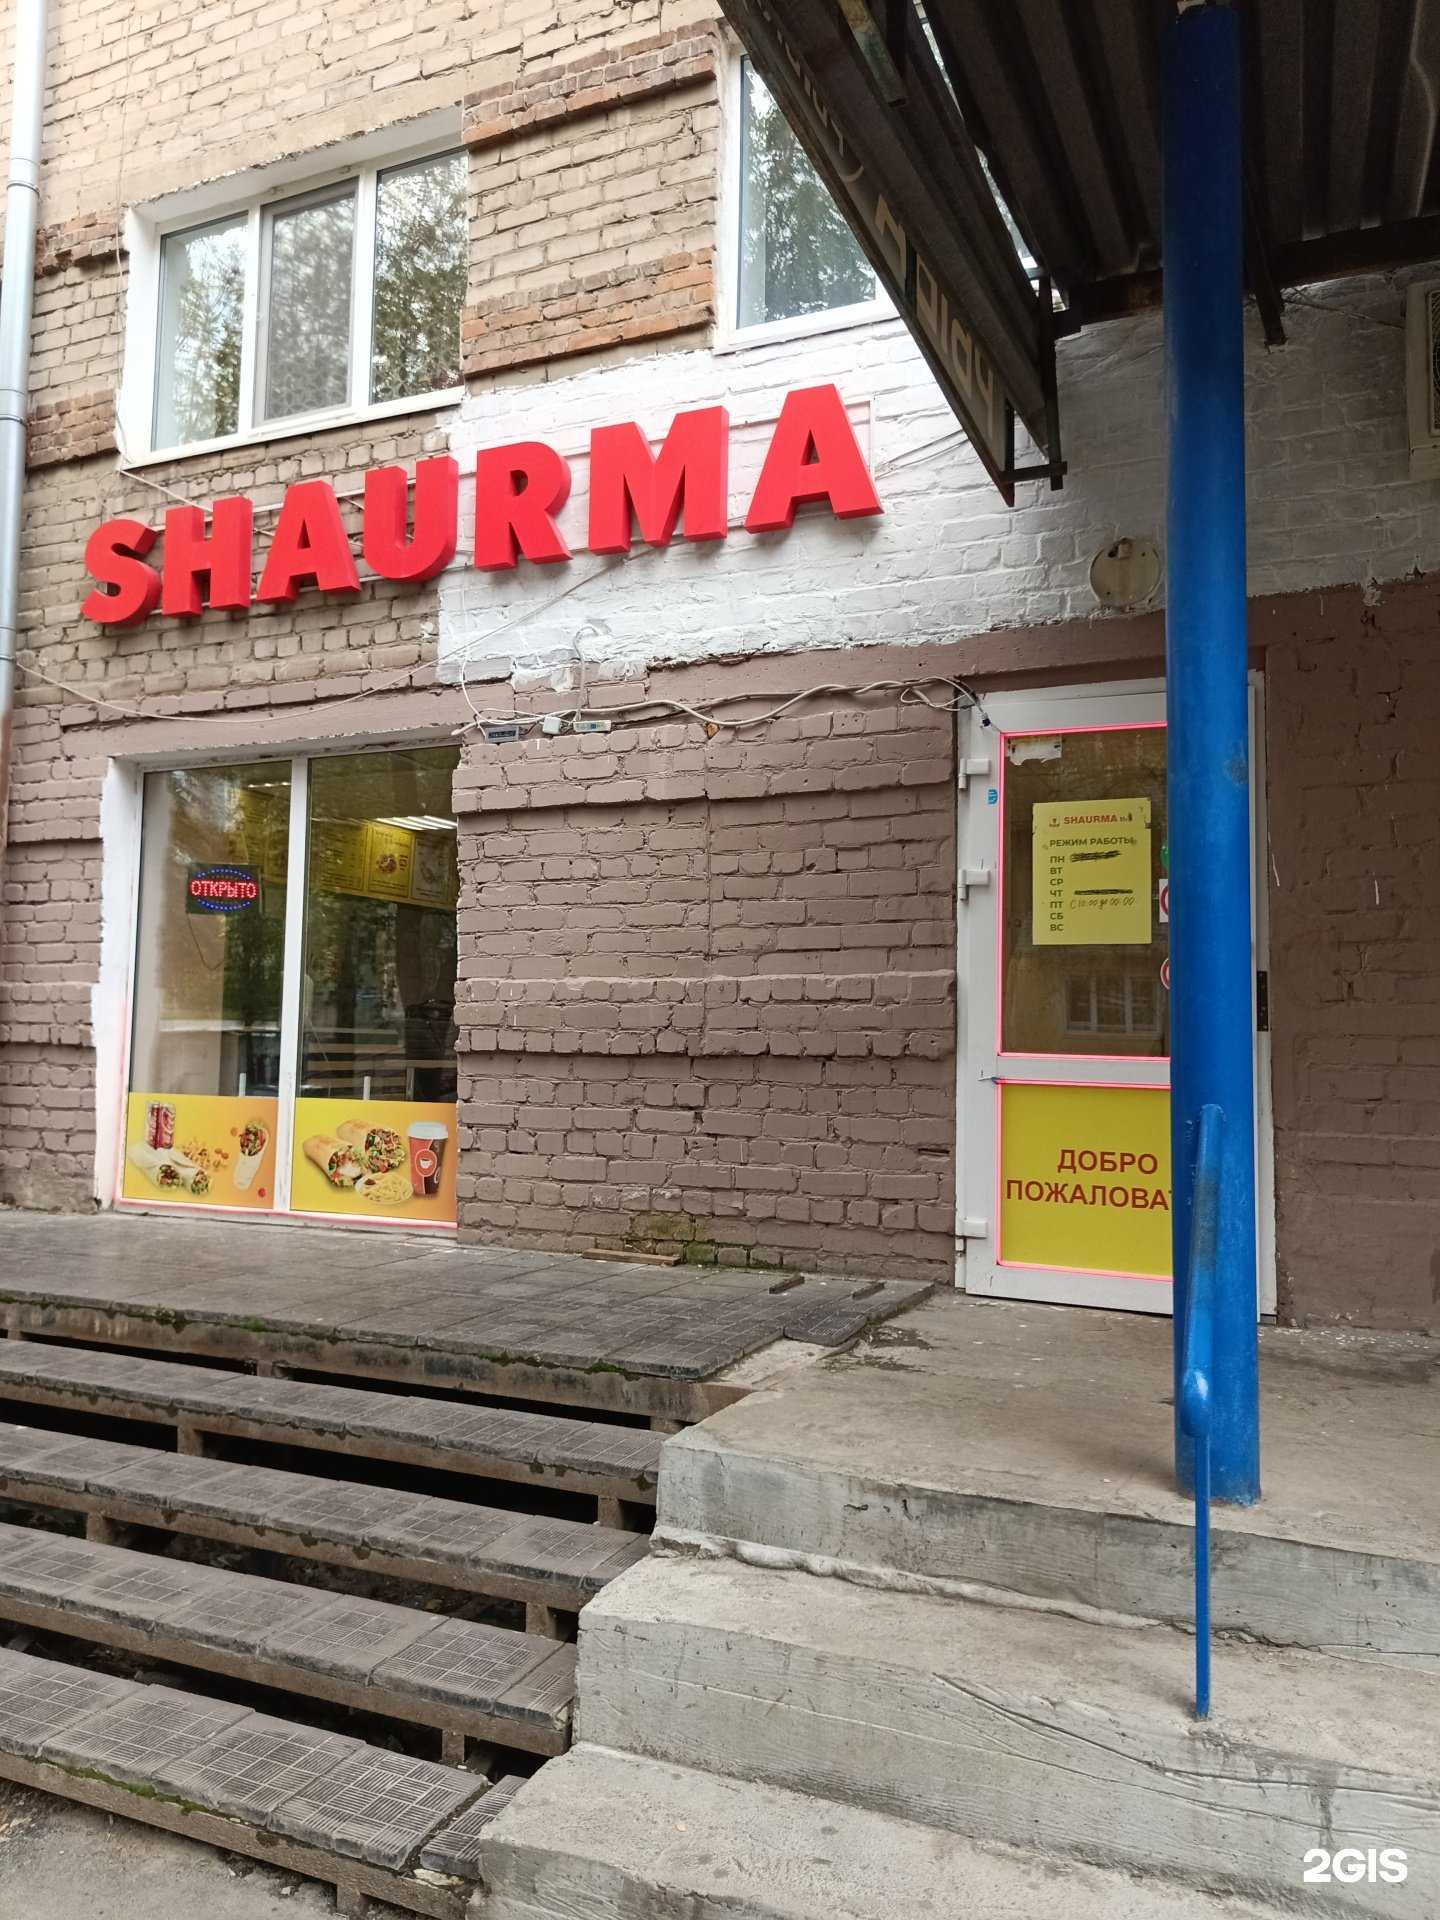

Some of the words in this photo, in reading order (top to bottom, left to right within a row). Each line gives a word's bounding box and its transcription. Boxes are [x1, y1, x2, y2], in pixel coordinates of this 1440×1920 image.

[83, 383, 884, 625] SHAURMA
[1063, 814, 1118, 825] SHAURMA
[1049, 838, 1088, 847] РЕЖИМ
[1050, 855, 1065, 864] ПН
[1050, 867, 1063, 875] ВТ
[1050, 878, 1064, 886] СР
[190, 879, 257, 899] ОТКРЫТО
[1050, 889, 1063, 897] ЧТ
[1050, 901, 1063, 909] ПТ
[1050, 912, 1064, 920] СБ
[1050, 923, 1064, 931] ВС
[1057, 1149, 1158, 1175] ДОБРО
[1006, 1179, 1172, 1210] ПОЖАЛОВА
